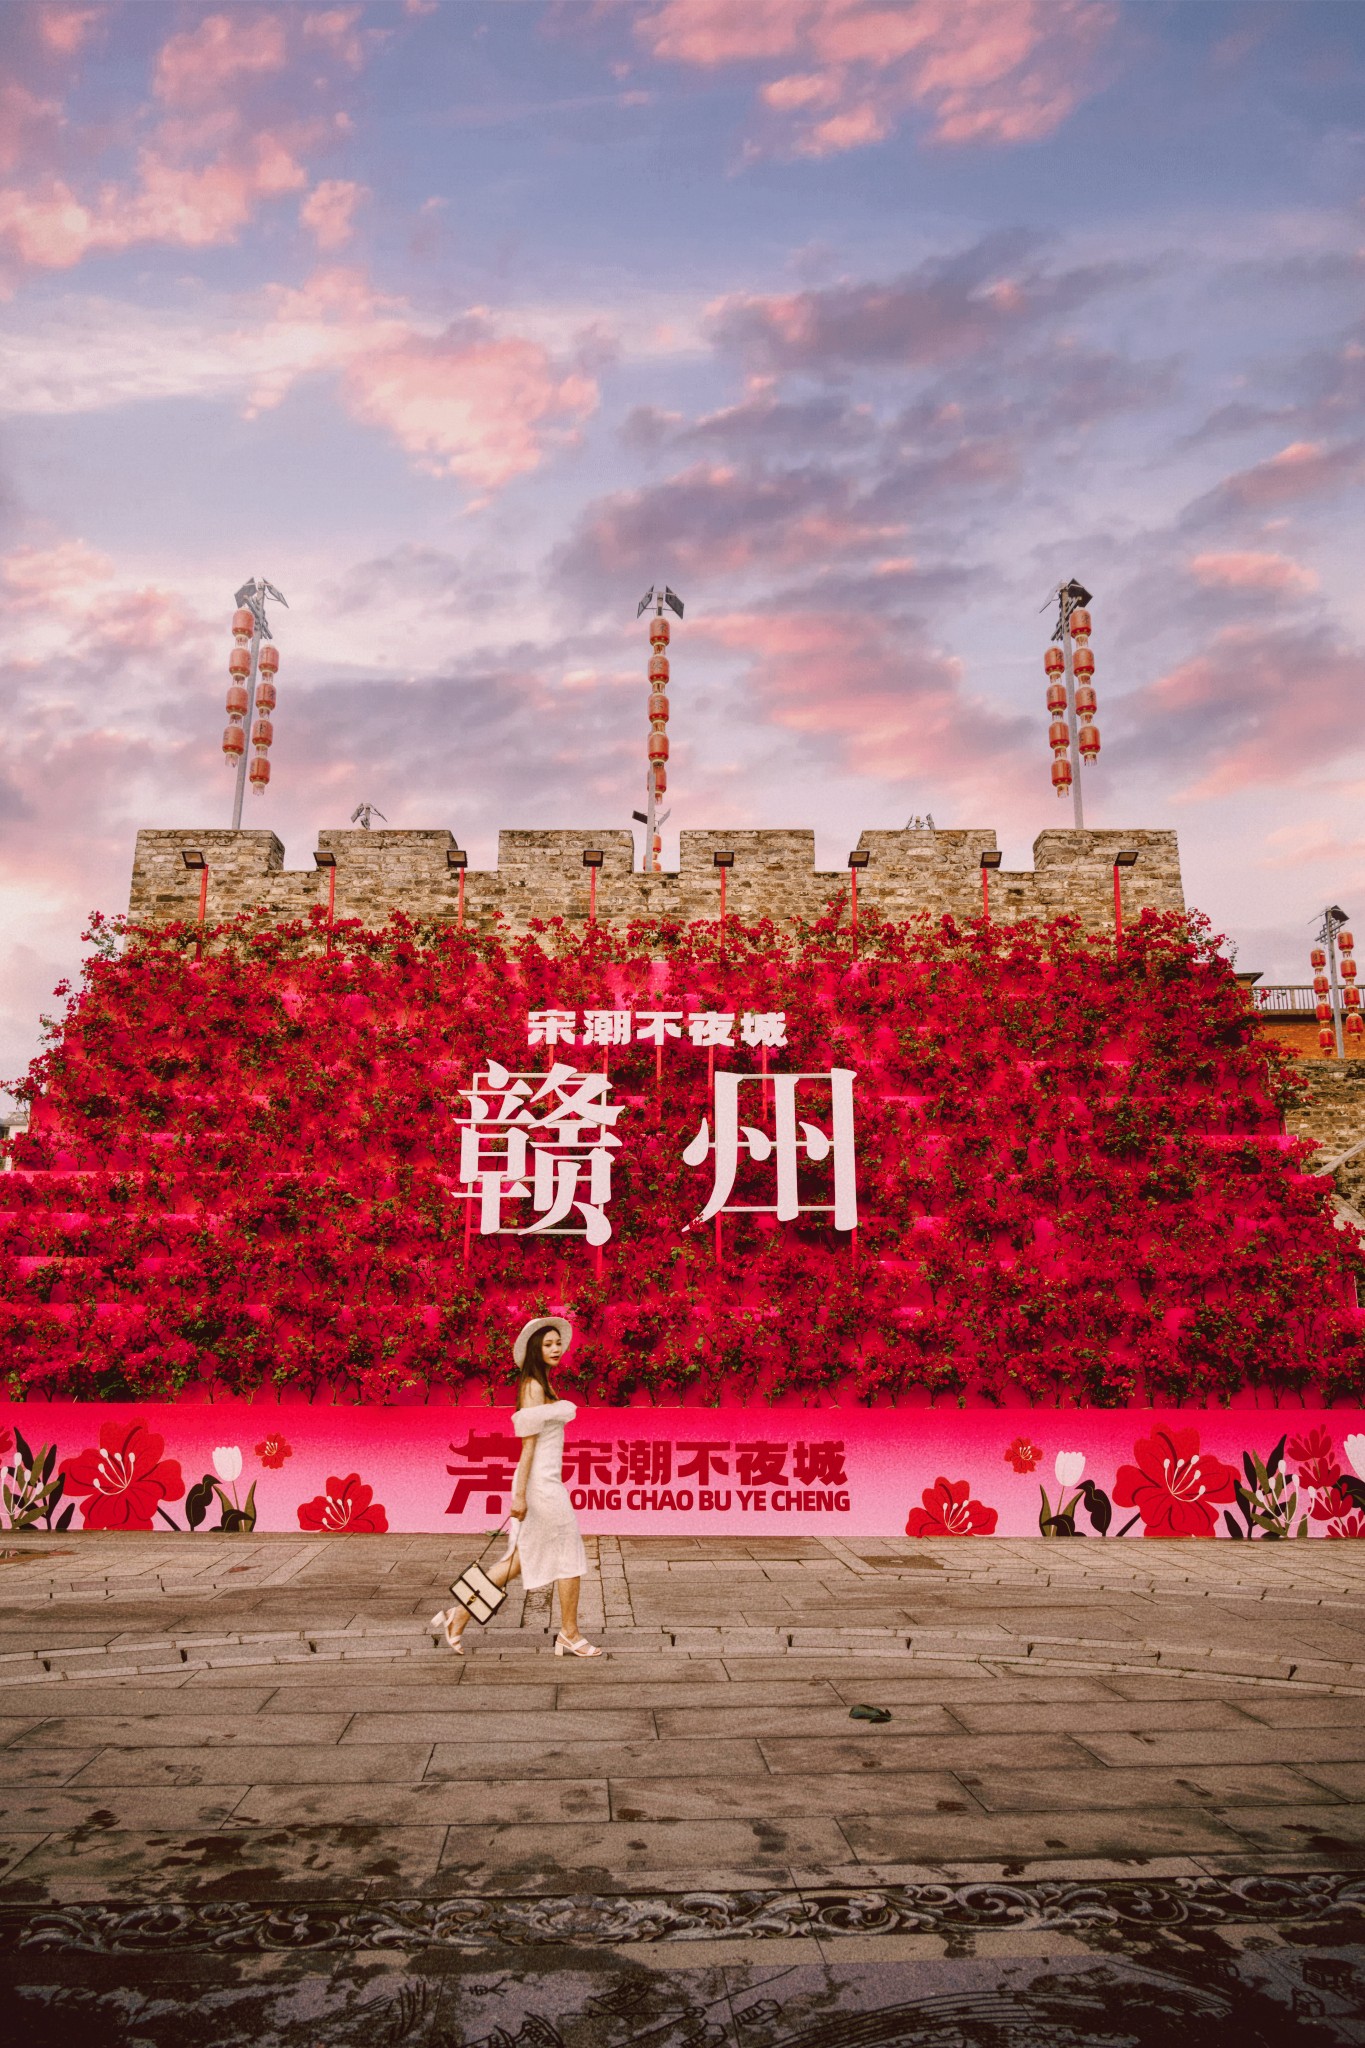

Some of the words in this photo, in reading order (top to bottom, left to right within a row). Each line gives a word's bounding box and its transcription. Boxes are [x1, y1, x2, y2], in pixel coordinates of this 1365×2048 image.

[527, 1009, 788, 1047] 宋潮不夜城
[451, 1058, 859, 1246] 赣州
[561, 1439, 848, 1486] 宋潮不夜城
[626, 1489, 694, 1511] CHAO
[698, 1489, 732, 1511] BU
[735, 1489, 767, 1512] YE
[770, 1489, 851, 1512] CHENG
